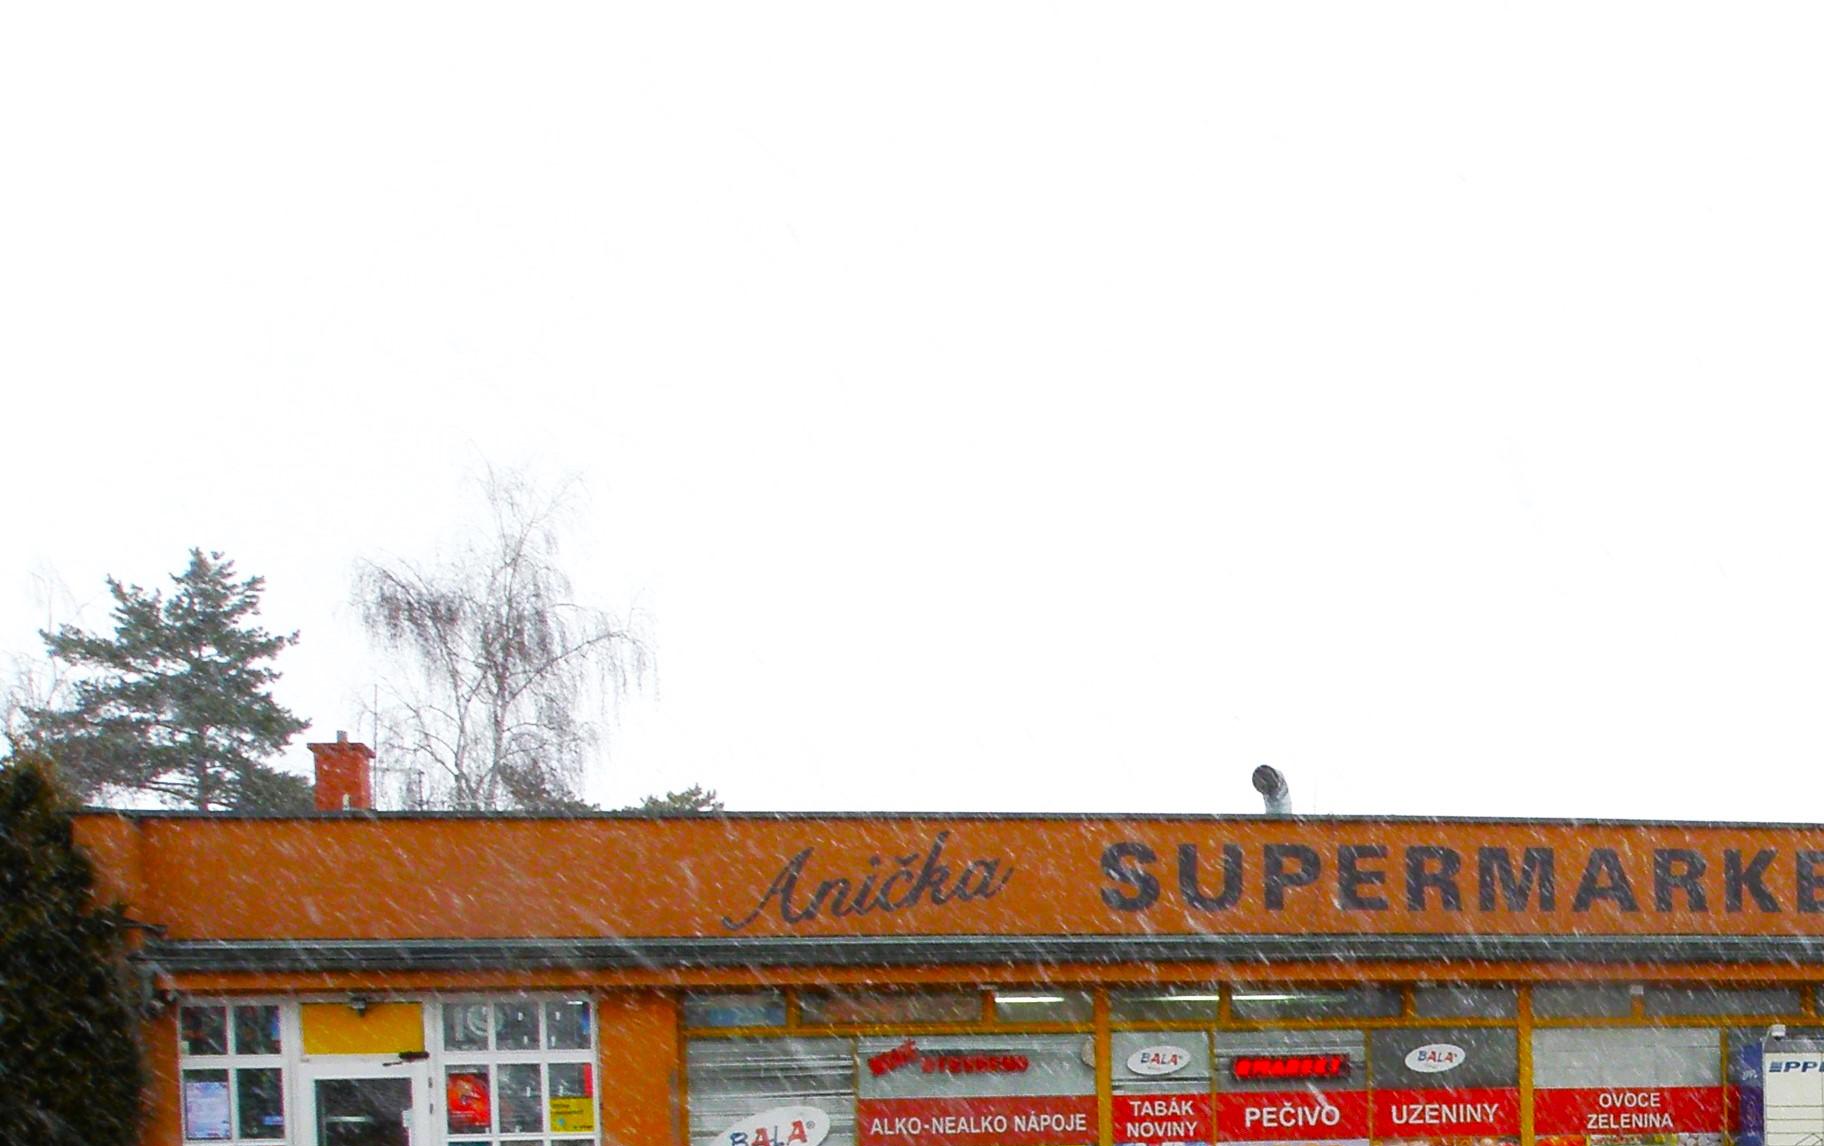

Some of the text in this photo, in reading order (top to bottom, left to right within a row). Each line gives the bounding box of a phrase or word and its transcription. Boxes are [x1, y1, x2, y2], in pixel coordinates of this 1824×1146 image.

[721, 830, 1014, 931] Anička
[1129, 1097, 1195, 1117] TABÁK
[1599, 1092, 1661, 1109] OVOCE
[869, 1110, 1088, 1136] ALKO-NEALKO NÁPOJE
[1244, 1101, 1341, 1128] PEČIVO
[1391, 1103, 1499, 1125] UZENINY
[1586, 1112, 1674, 1130] ZELENINA
[1126, 1121, 1198, 1138] NOVINY
